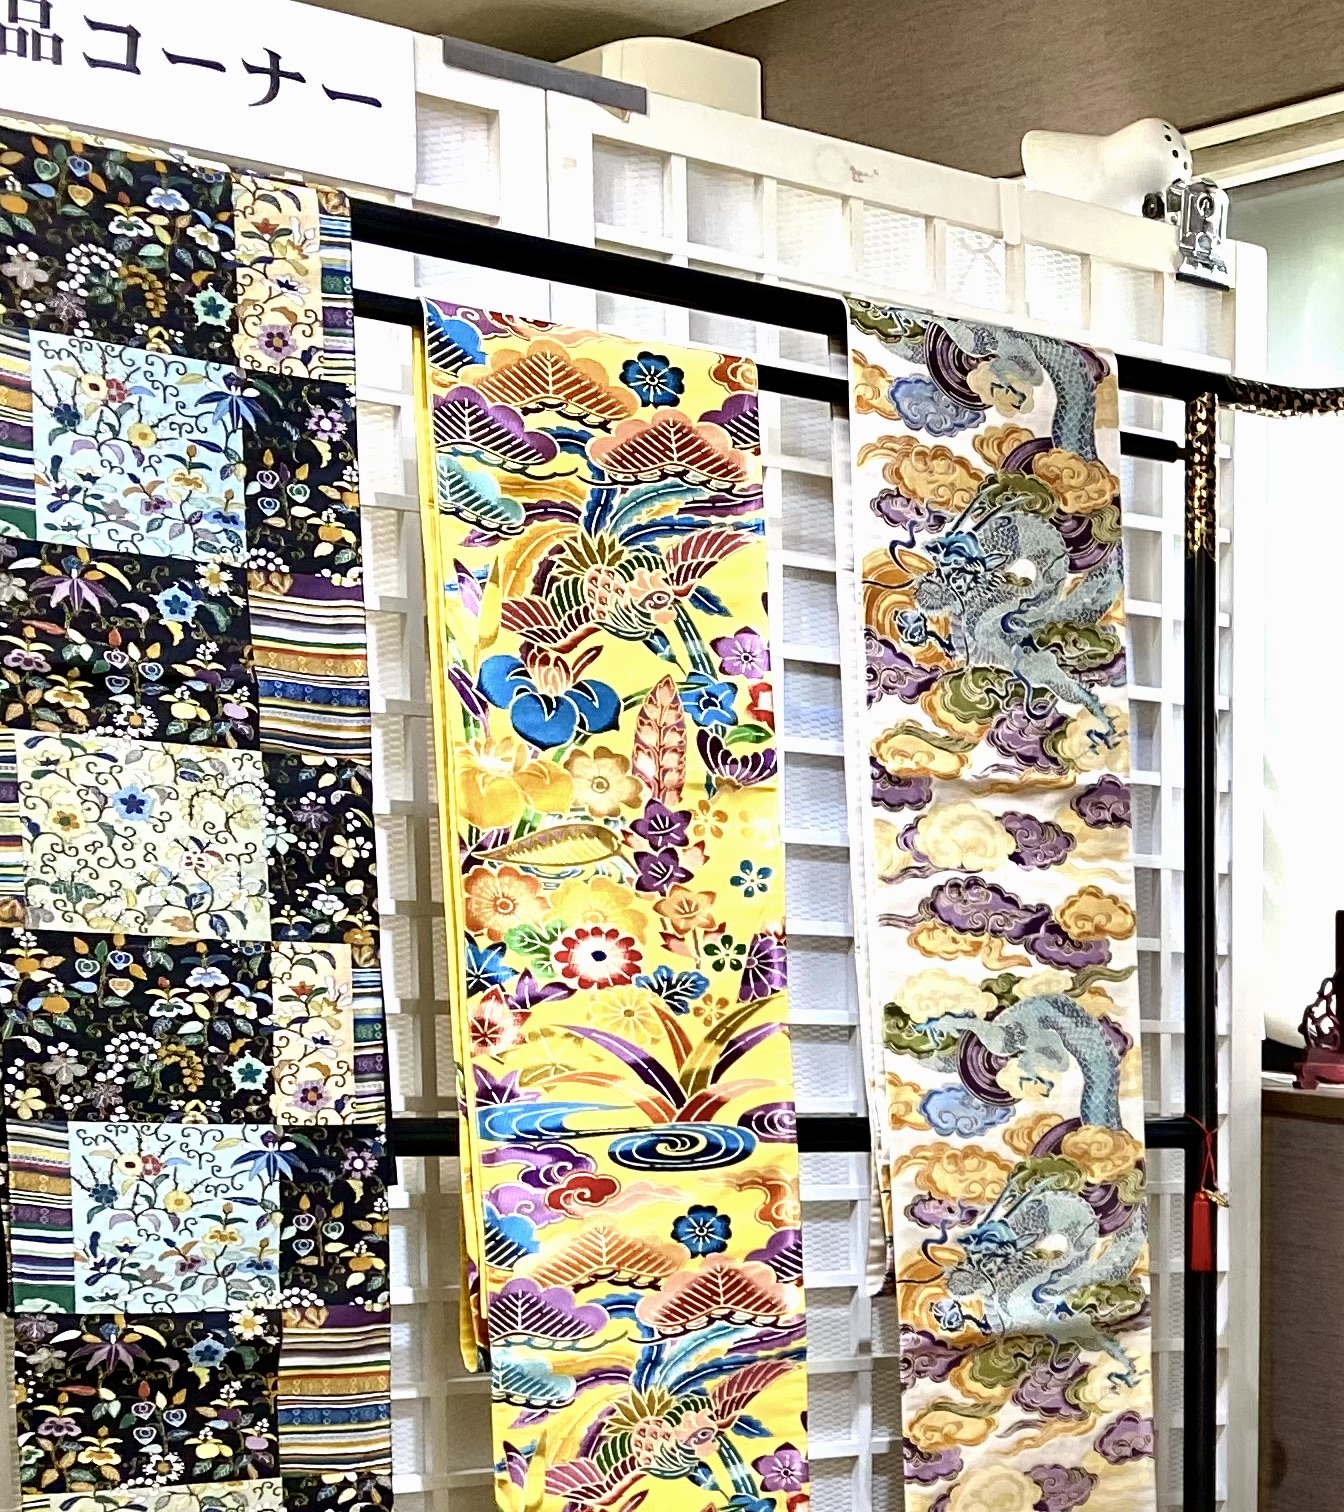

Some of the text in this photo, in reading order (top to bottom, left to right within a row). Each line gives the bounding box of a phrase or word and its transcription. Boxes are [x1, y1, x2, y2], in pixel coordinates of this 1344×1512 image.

[0, 0, 382, 108] 品コーナー
